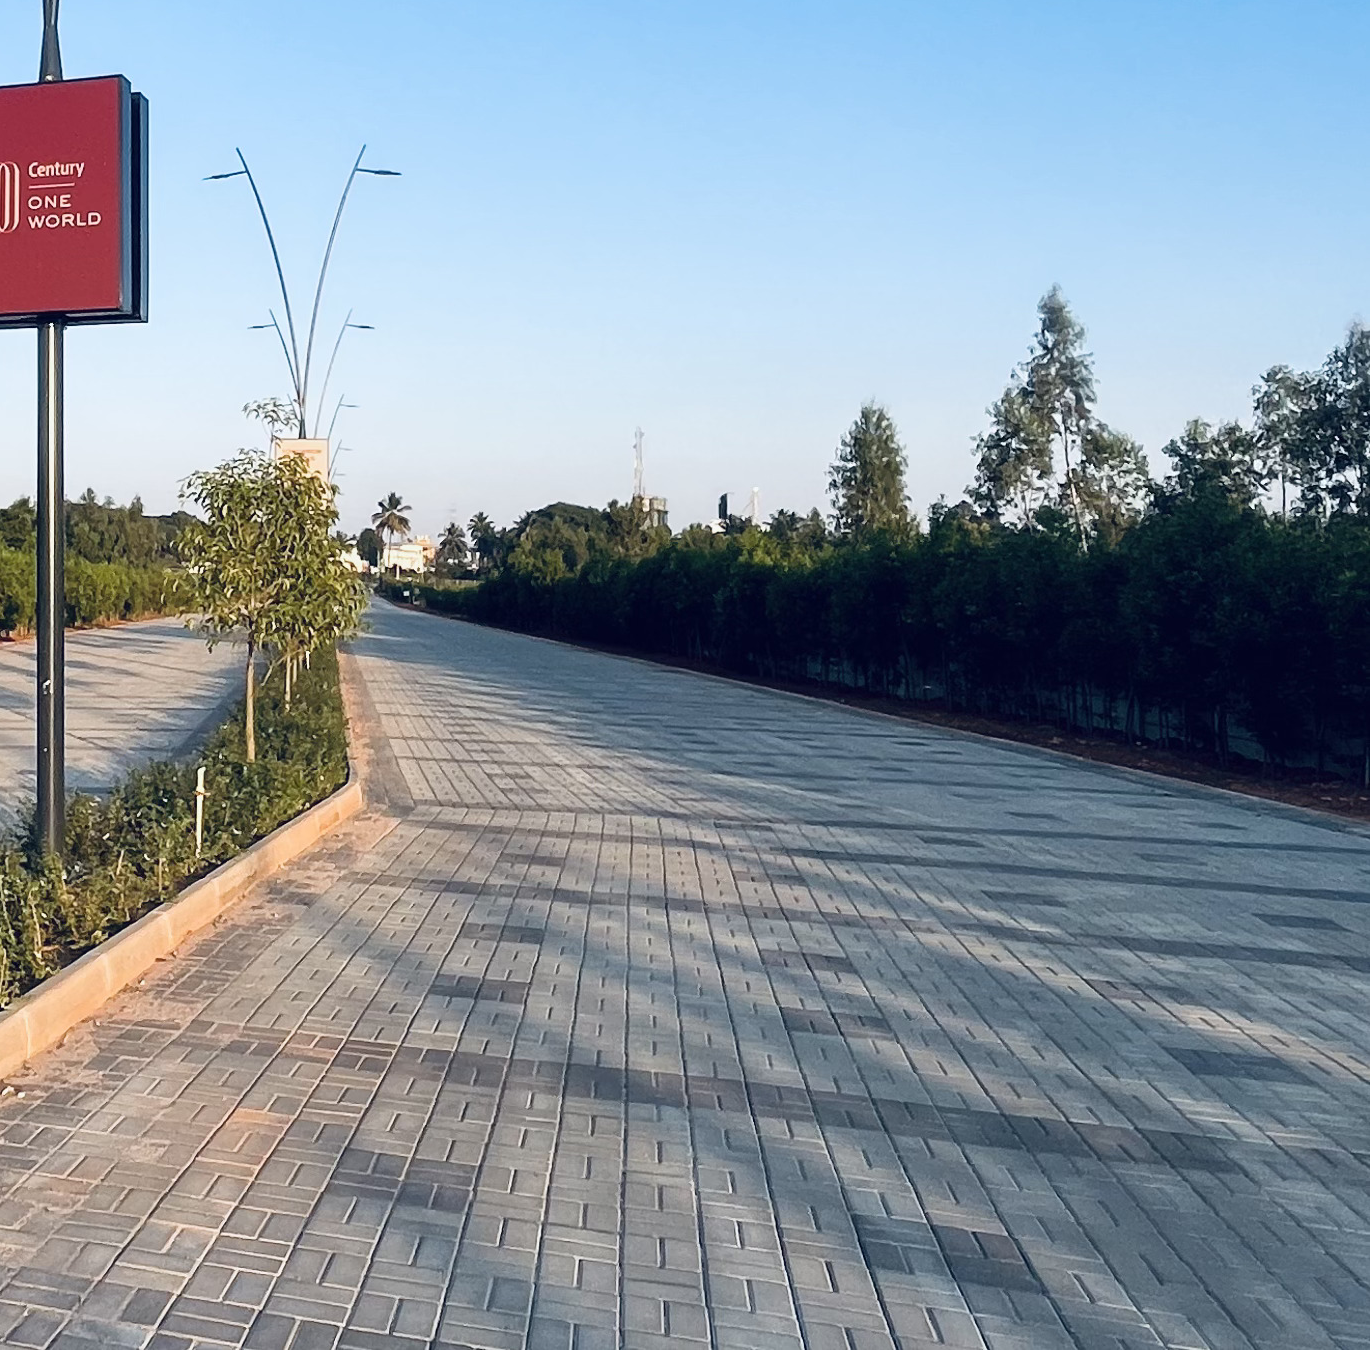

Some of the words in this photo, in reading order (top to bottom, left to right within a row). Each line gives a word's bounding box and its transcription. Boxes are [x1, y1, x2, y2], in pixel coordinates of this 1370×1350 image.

[28, 161, 85, 178] Century
[27, 194, 72, 210] ONE
[27, 212, 102, 229] WORLD
